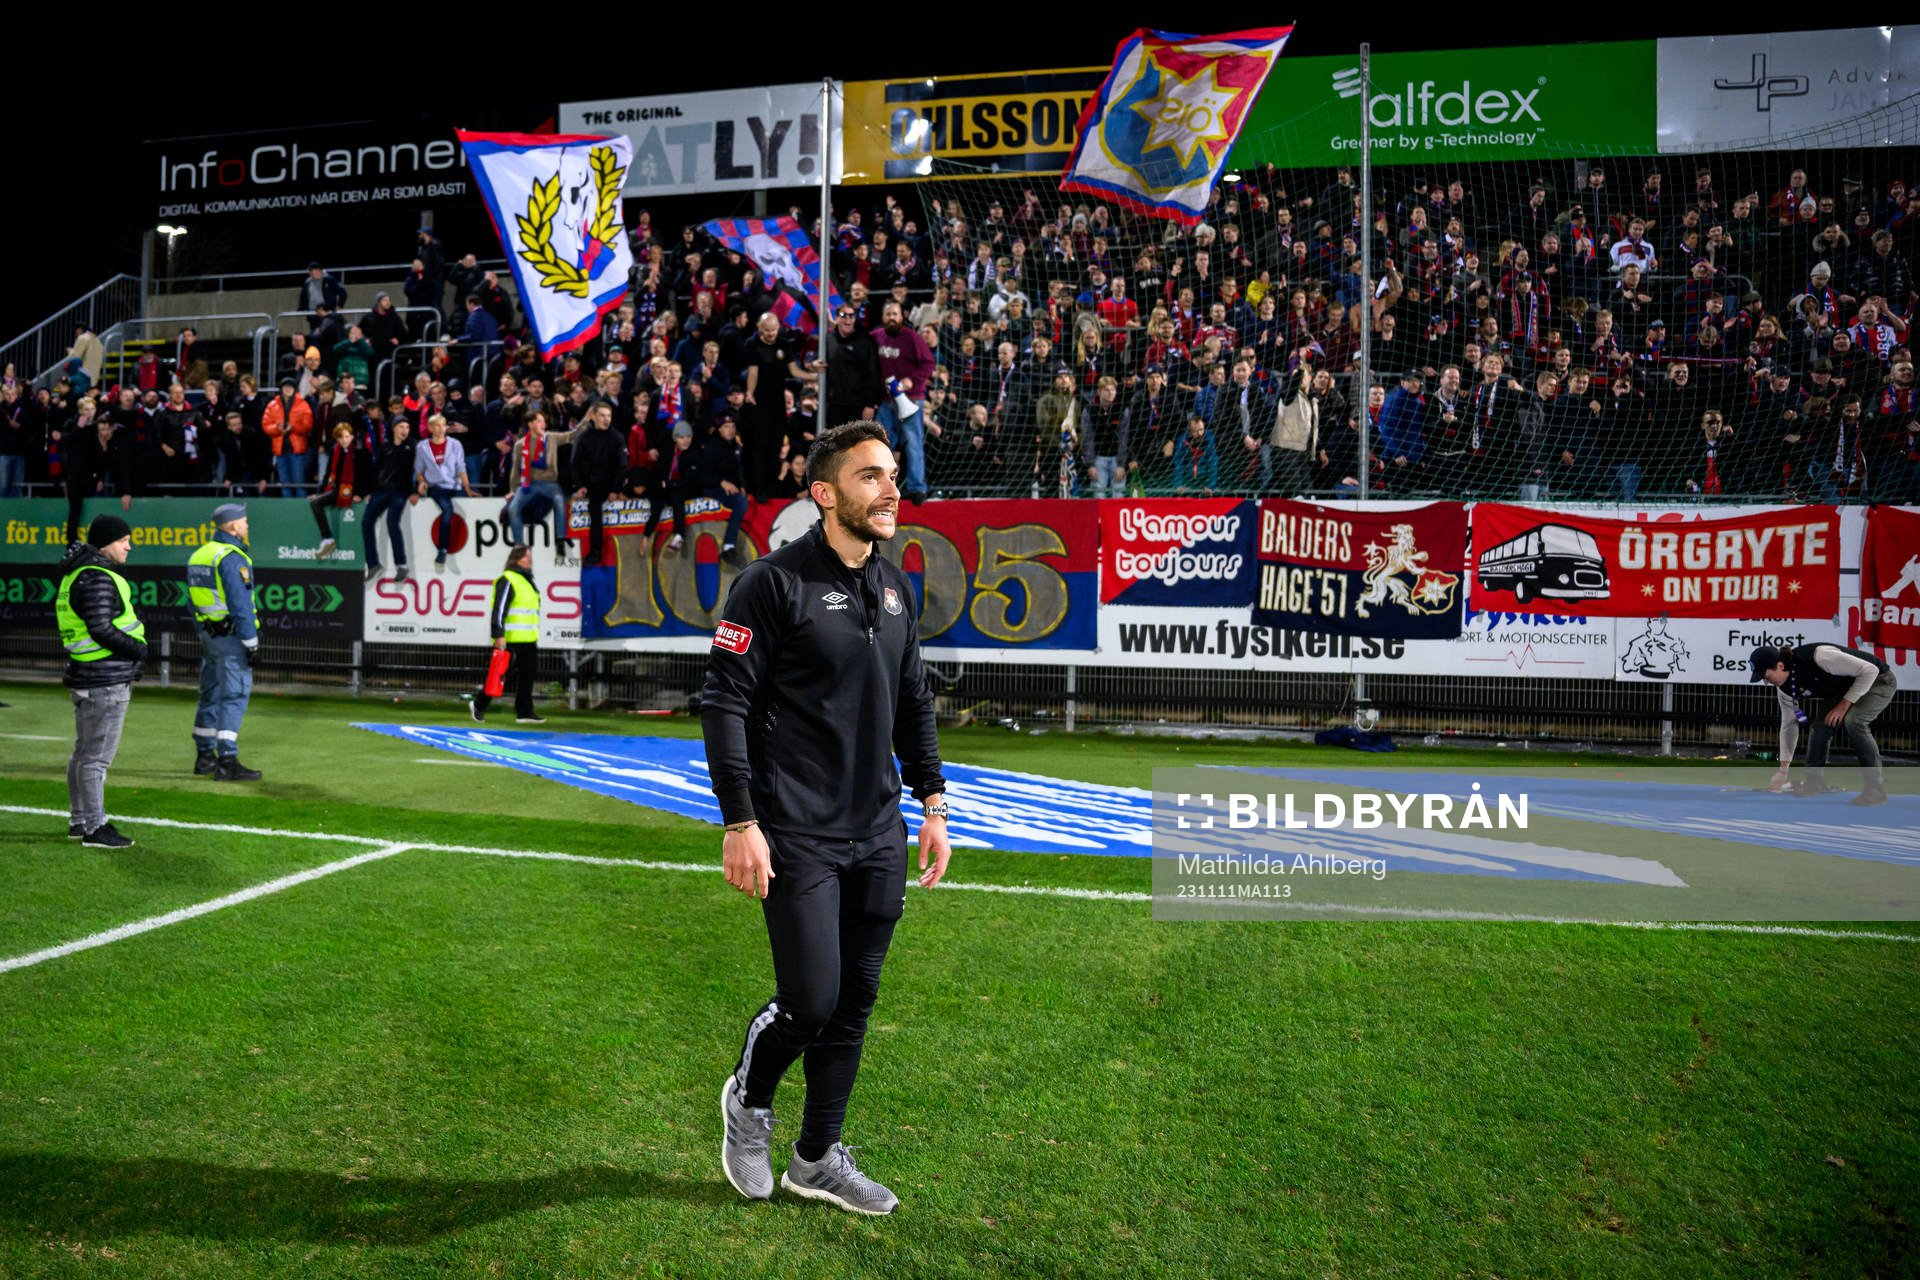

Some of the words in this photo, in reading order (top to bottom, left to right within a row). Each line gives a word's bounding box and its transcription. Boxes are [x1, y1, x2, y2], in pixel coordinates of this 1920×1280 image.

[582, 111, 612, 125] THE
[616, 106, 683, 122] ORIGINAL
[1368, 80, 1541, 127] alfdex
[590, 114, 818, 188] ATLY!
[1400, 133, 1419, 150] by
[1425, 130, 1536, 150] g-Technology
[159, 203, 200, 217] DIGITAL
[204, 196, 307, 212] KOMMUNIKATION
[310, 190, 338, 205] NÄR
[341, 189, 368, 203] DEN
[372, 187, 390, 201] ÄR
[394, 185, 424, 198] SOM
[428, 182, 466, 196] BÄST!
[6, 519, 39, 544] för
[131, 520, 249, 546] enerati
[1119, 507, 1240, 548] L'amour
[1261, 509, 1352, 562] BALDERS
[1618, 522, 1829, 570] ÖRGRYTE
[1115, 549, 1242, 586] toujours
[1663, 576, 1701, 602] ON
[1707, 575, 1779, 601] TOUR
[826, 603, 848, 611] umbro
[716, 625, 748, 643] NIBET
[1486, 632, 1495, 643] &
[1500, 633, 1608, 646] MOTIONSCENTER
[1728, 630, 1805, 648] Frukost
[1713, 655, 1751, 671] Bes
